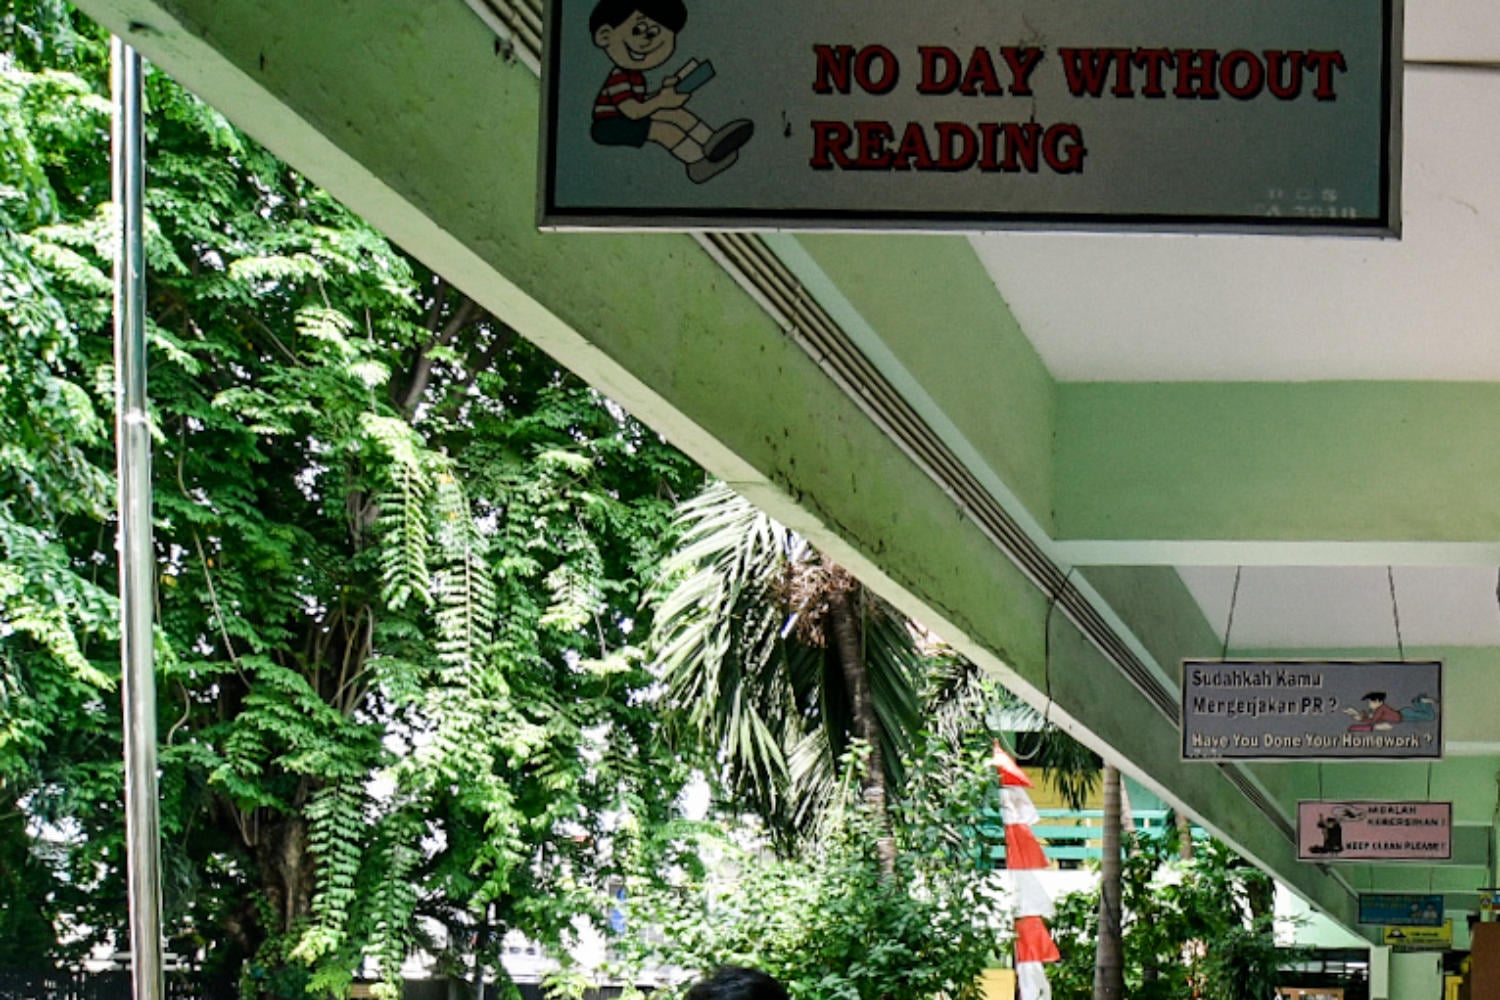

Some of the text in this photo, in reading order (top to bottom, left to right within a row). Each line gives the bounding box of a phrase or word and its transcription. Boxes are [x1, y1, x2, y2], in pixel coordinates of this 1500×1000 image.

[813, 45, 1346, 100] NO DAY WITHOUT
[810, 120, 1087, 174] READING
[1191, 670, 1323, 688] Sudahkah Kamu
[1193, 697, 1300, 717] Mengerjakan
[1301, 697, 1324, 714] PR
[1191, 733, 1229, 748] Have
[1233, 733, 1259, 748] You
[1264, 733, 1301, 748] Done
[1305, 733, 1338, 748] Your
[1342, 733, 1420, 748] Homework
[1346, 841, 1370, 850] KEEP
[1404, 841, 1439, 850] PLEASE
